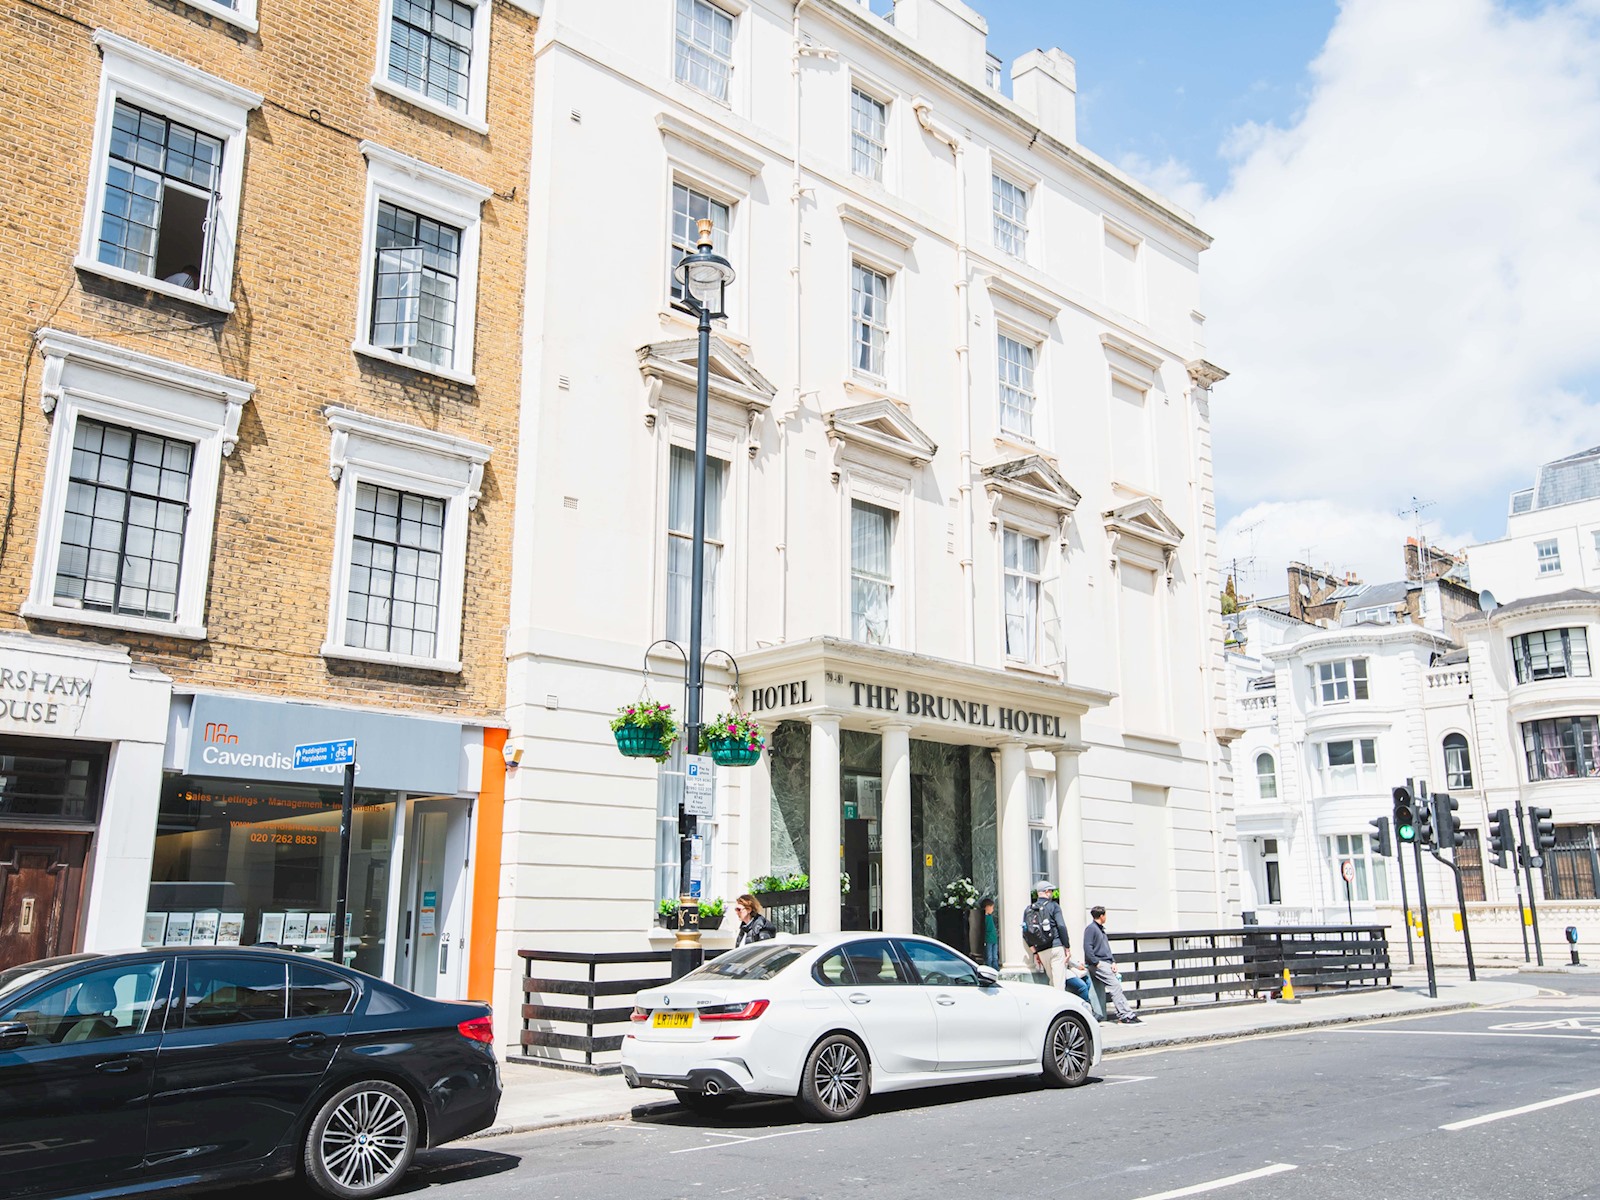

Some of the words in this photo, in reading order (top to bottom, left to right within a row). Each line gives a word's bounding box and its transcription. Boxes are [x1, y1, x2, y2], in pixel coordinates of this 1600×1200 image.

[0, 667, 92, 698] RSHAM
[752, 680, 812, 712] HOTEL
[850, 681, 900, 712] THE
[906, 690, 995, 728] BRUNEL
[1000, 706, 1067, 739] HOTEL
[202, 746, 293, 771] Cavendis
[185, 791, 212, 801] Sales
[222, 794, 258, 806] Lettings
[268, 797, 323, 809] Management
[250, 833, 268, 842] 020
[271, 834, 293, 843] 7262
[295, 835, 317, 845] 8833
[441, 932, 450, 941] 32
